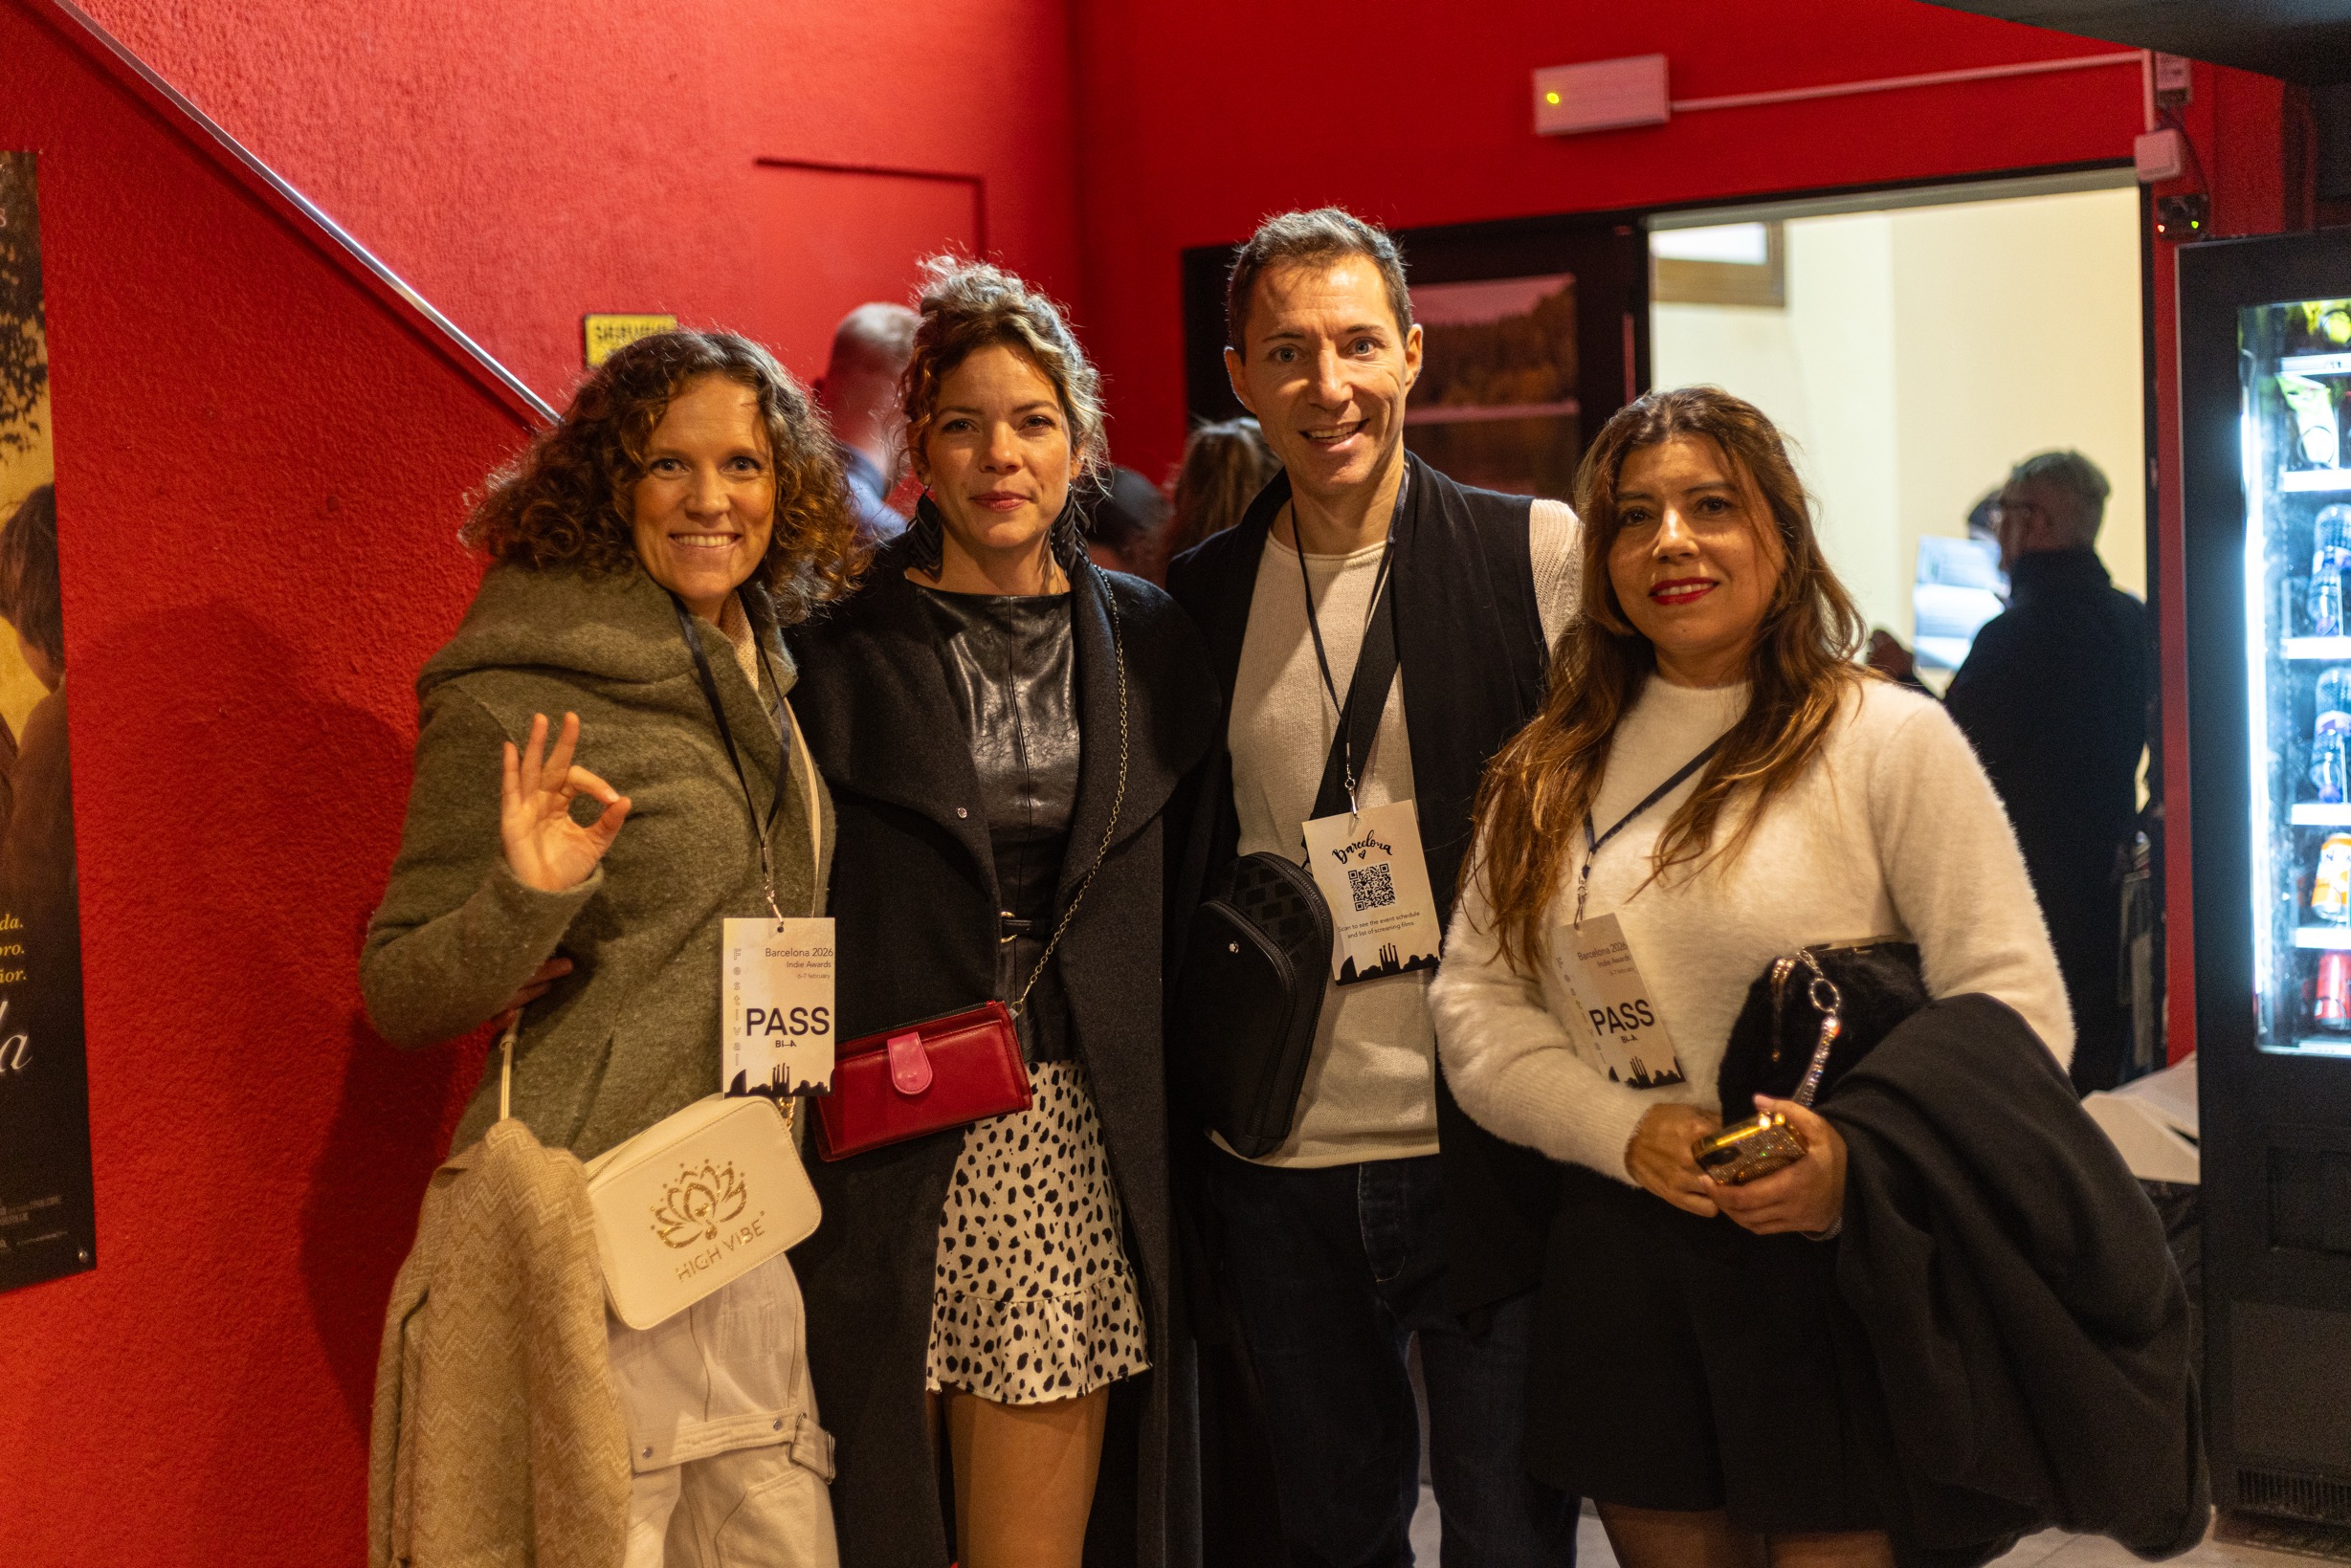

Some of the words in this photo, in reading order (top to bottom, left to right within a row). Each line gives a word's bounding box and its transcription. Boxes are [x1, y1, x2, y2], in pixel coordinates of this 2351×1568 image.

[1332, 828, 1393, 865] Barcelona
[0, 914, 24, 930] da.
[1395, 911, 1420, 920] schedule
[1374, 923, 1401, 934] screening
[765, 947, 810, 958] Barcelona
[811, 947, 834, 958] 2026
[1577, 947, 1611, 961] Barcelona
[1609, 941, 1629, 953] 2026
[746, 1006, 831, 1036] PASS
[1588, 999, 1655, 1036] PASS
[676, 1245, 722, 1282] HIGH
[722, 1218, 765, 1252] VIBE
